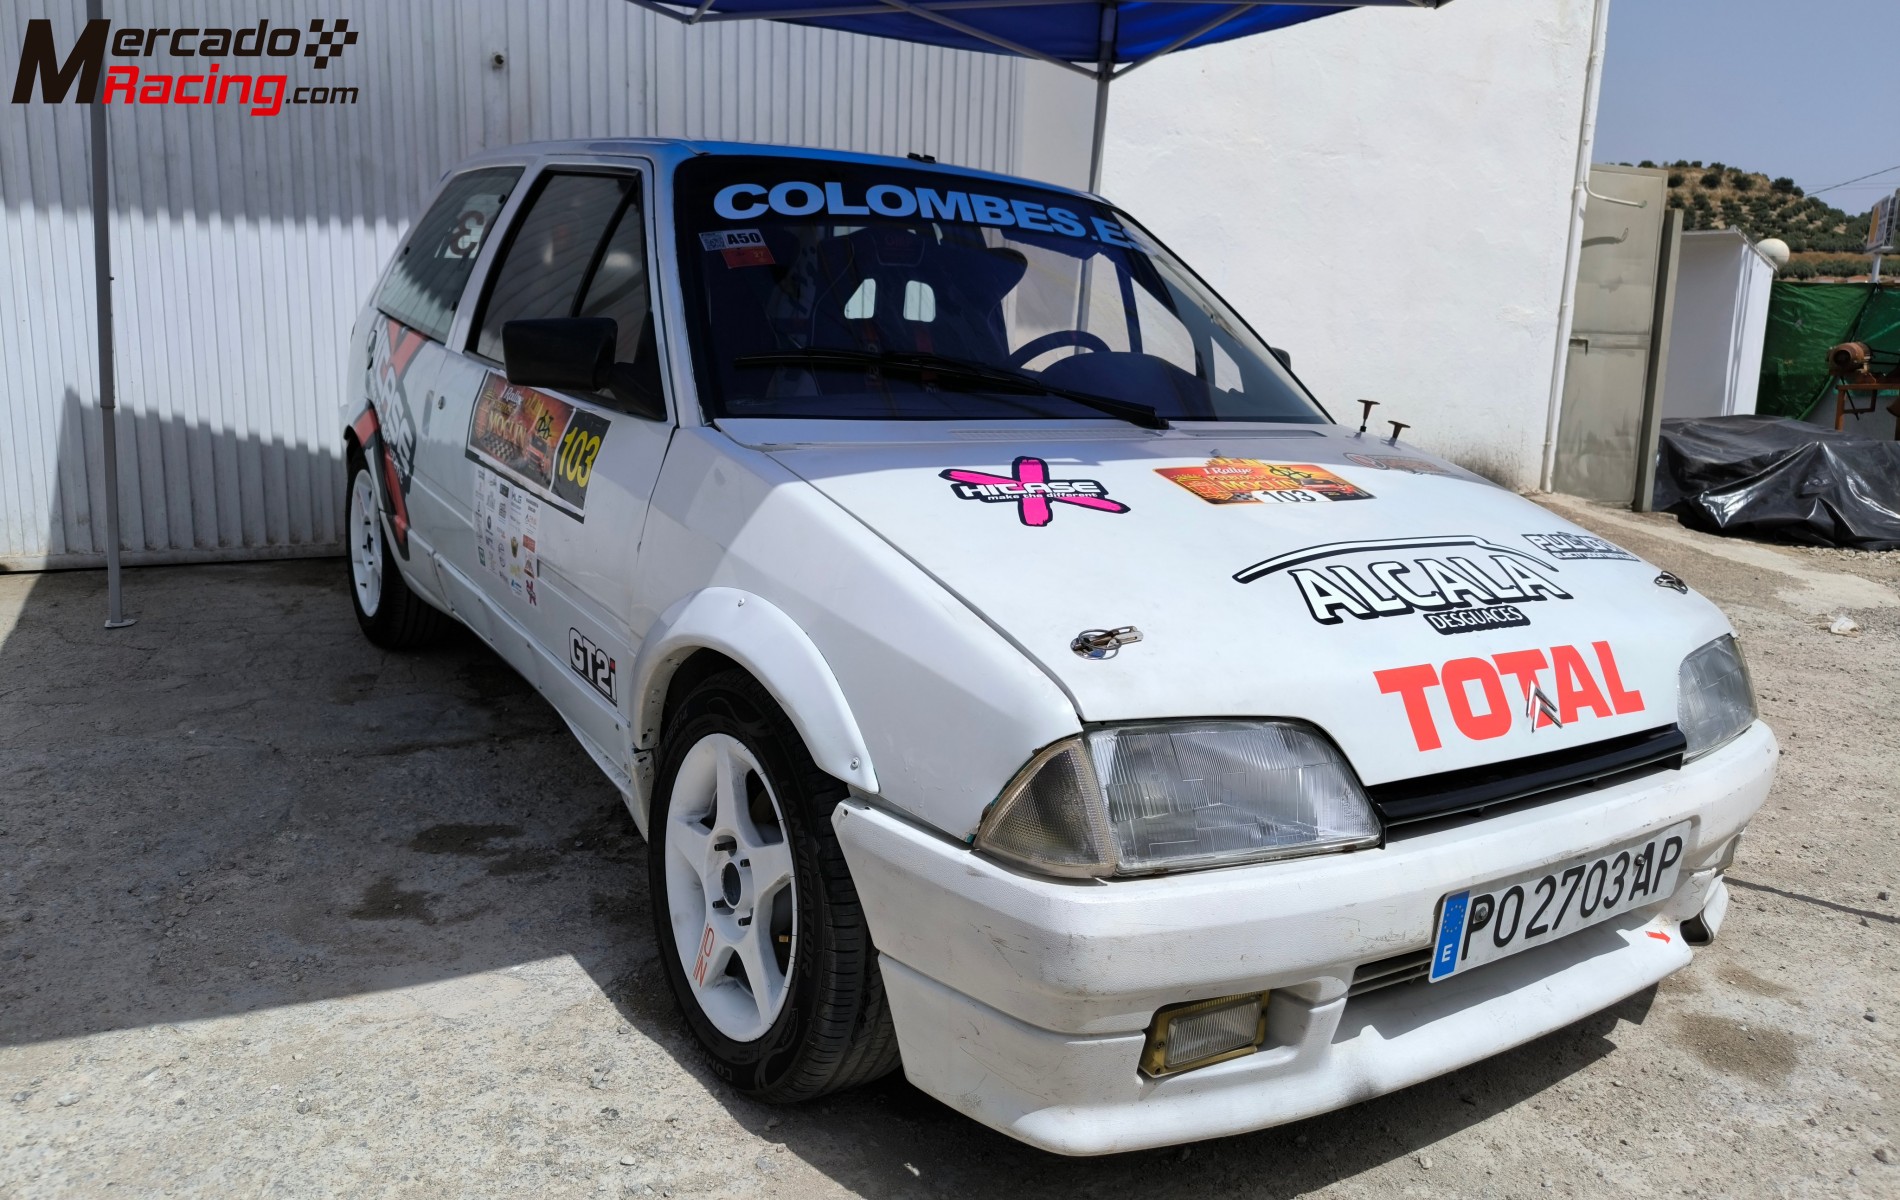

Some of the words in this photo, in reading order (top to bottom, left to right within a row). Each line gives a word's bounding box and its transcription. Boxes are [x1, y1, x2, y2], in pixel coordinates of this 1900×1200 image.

[726, 232, 762, 245] A50
[559, 426, 601, 488] 103
[1210, 466, 1253, 476] Rallye
[1217, 477, 1301, 490] MOCLÍN
[1046, 491, 1098, 499] different
[1262, 489, 1317, 503] 103
[1288, 554, 1574, 626] ALCALA
[1427, 606, 1524, 631] DESGUACES
[568, 626, 618, 704] GT2i
[1373, 640, 1645, 753] TOTAL
[1441, 943, 1453, 963] E
